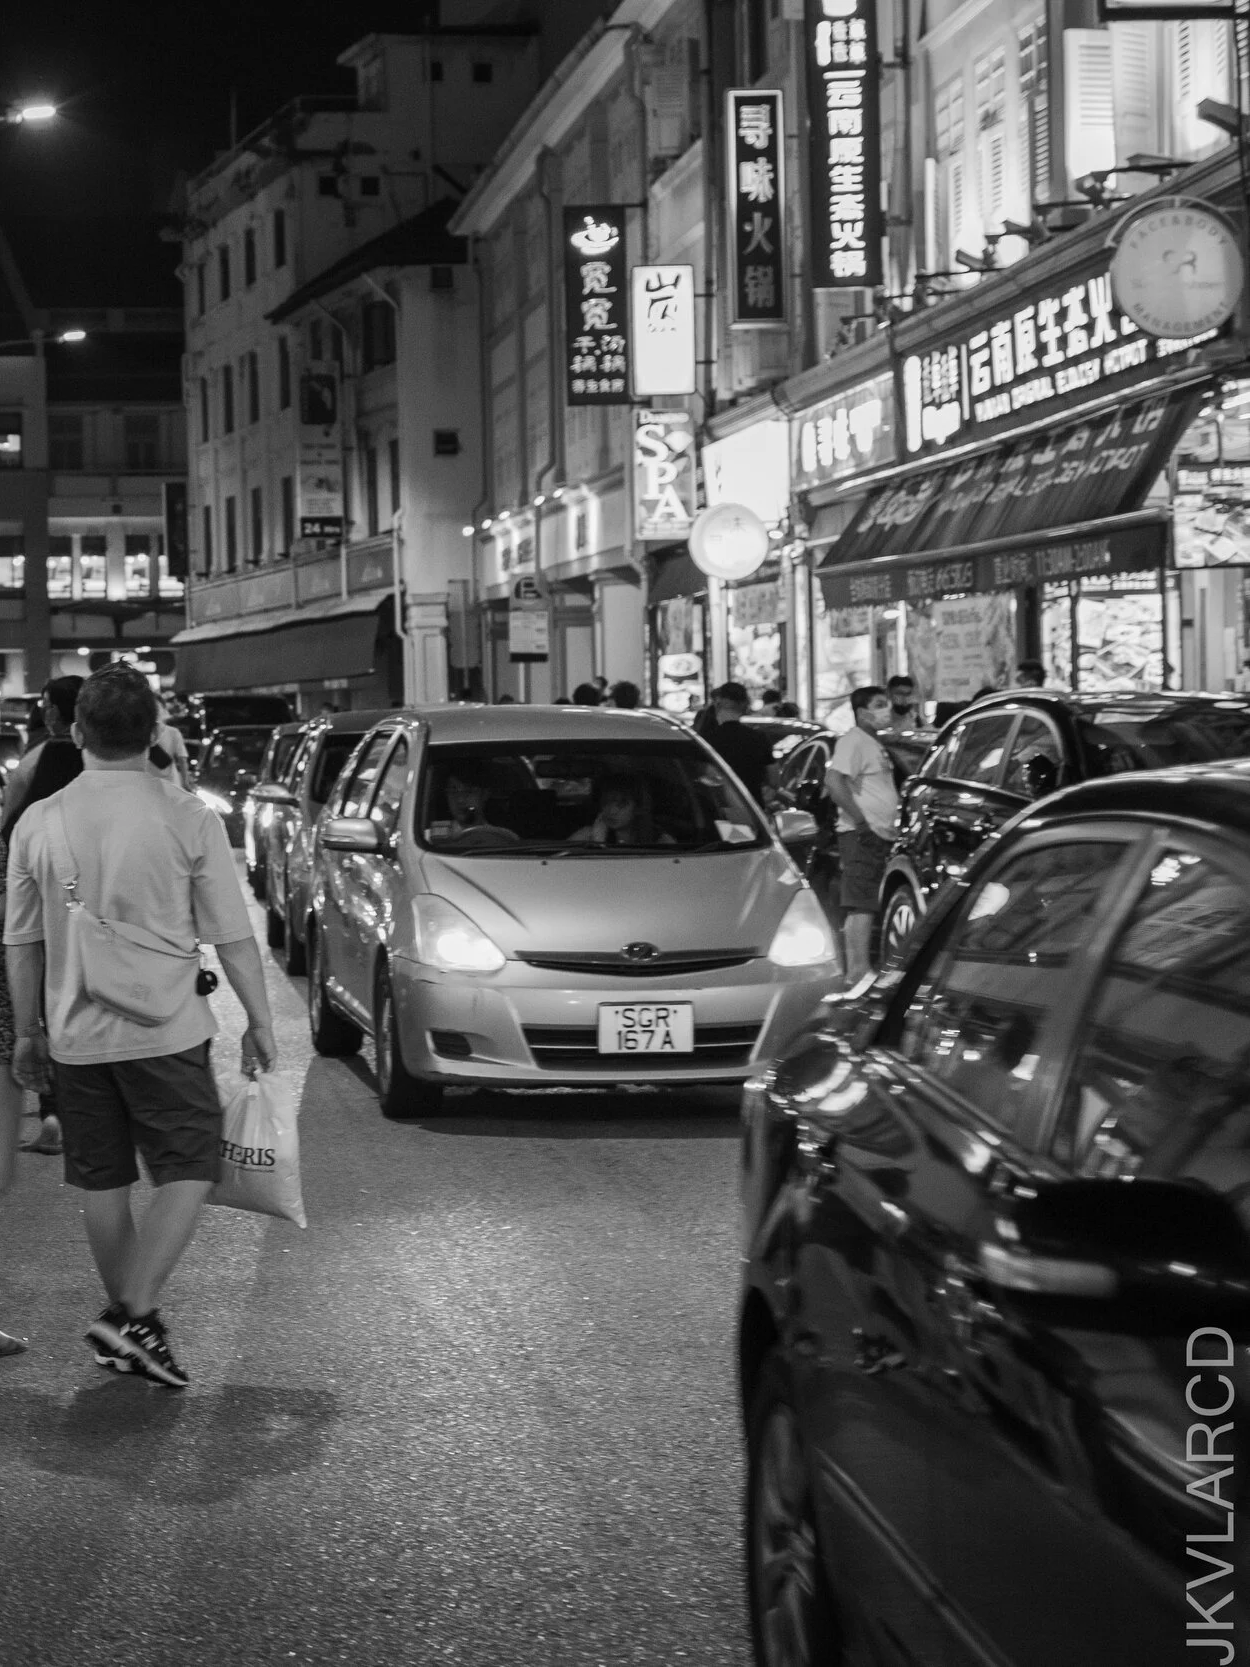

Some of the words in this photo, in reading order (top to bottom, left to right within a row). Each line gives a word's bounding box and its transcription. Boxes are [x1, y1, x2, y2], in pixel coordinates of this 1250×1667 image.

[969, 272, 1139, 396] 云南原生态火
[635, 424, 693, 522] SPA
[303, 522, 320, 533] 24
[622, 1008, 670, 1028] SGR
